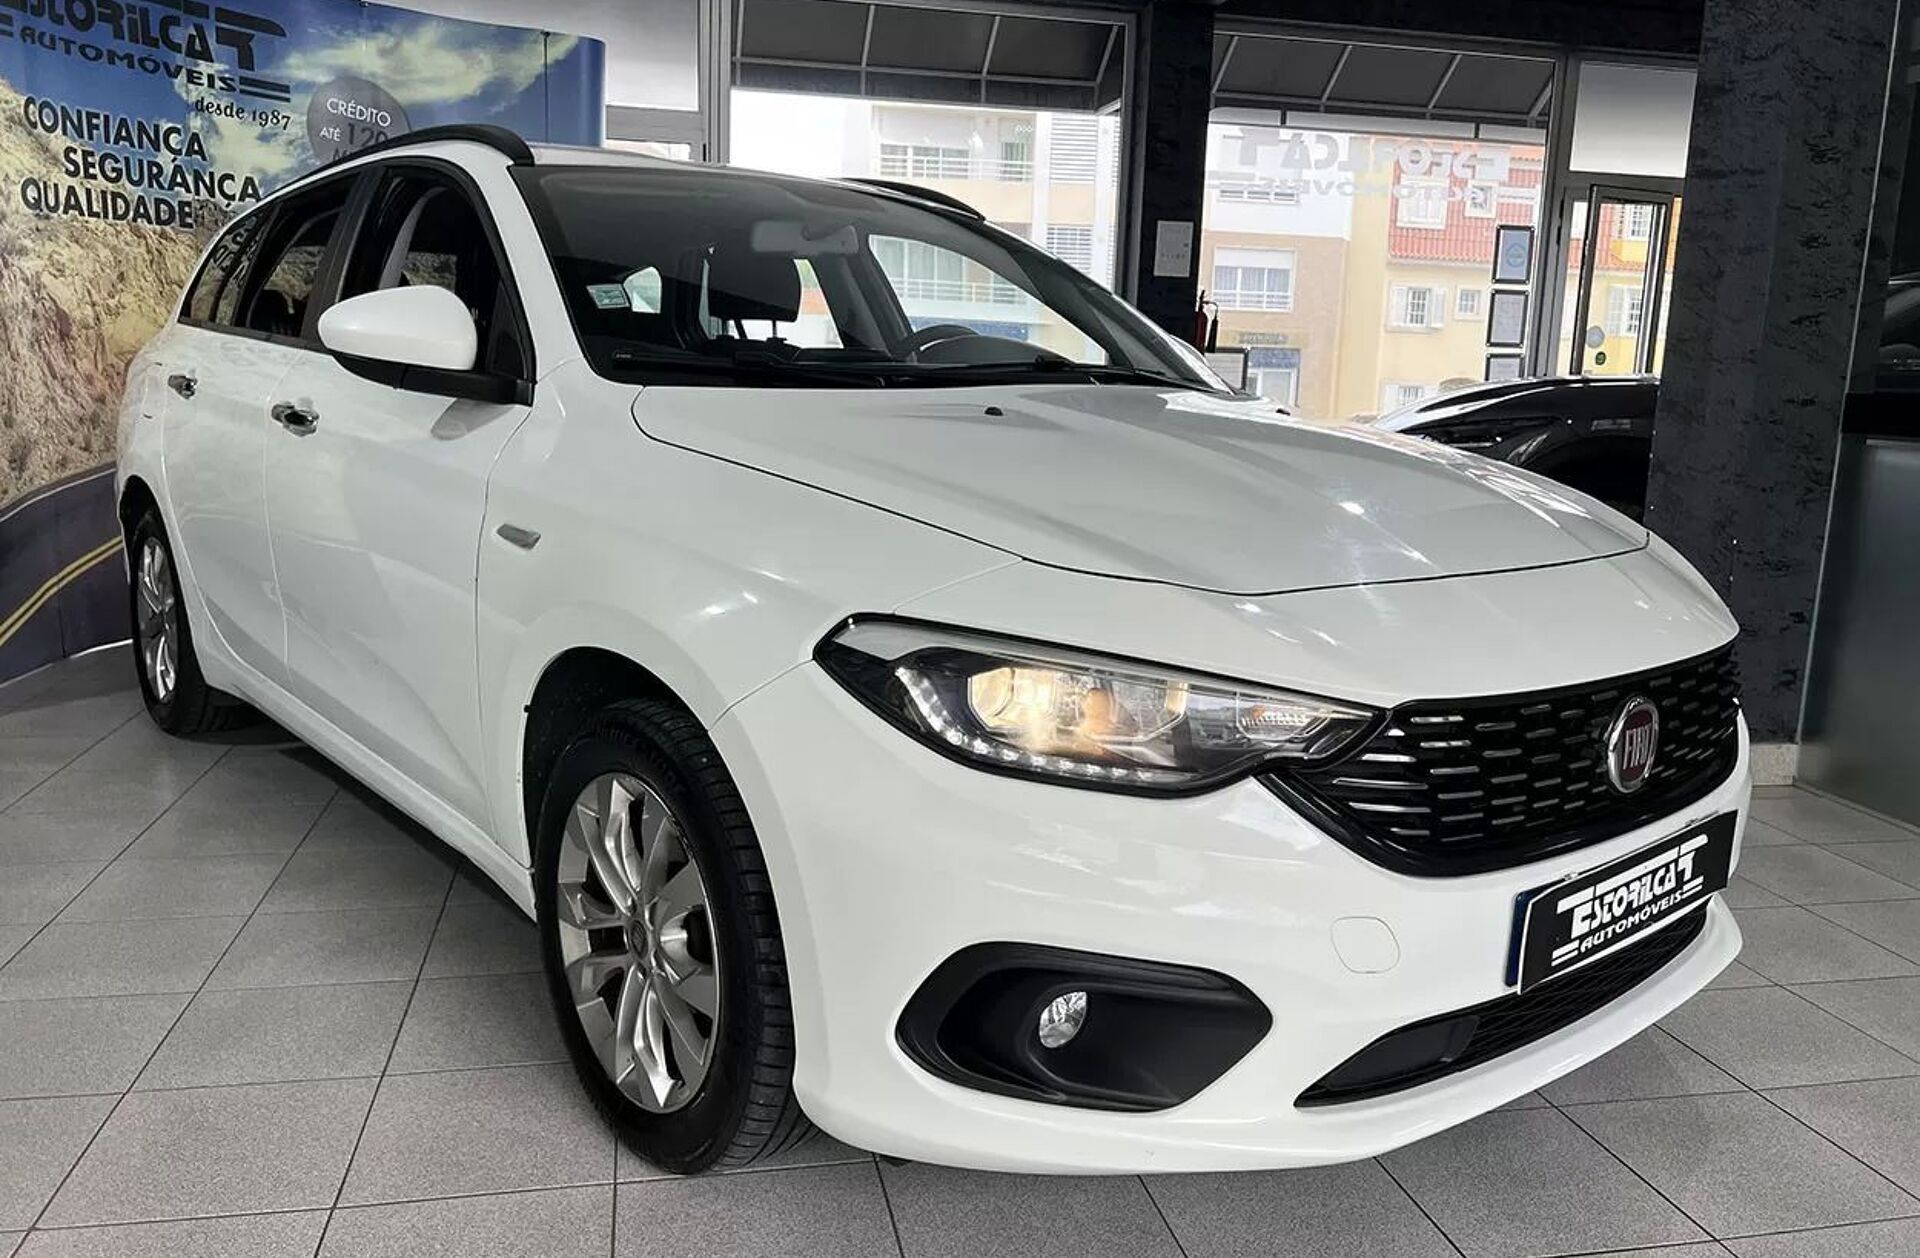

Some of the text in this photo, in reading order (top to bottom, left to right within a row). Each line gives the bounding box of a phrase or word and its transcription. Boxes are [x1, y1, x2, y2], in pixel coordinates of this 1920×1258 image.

[20, 26, 237, 93] AUTOMÓVEIS
[24, 96, 206, 163] CONFIANÇA
[195, 97, 291, 130] desde 1987
[320, 127, 341, 142] ATÉ
[327, 98, 391, 127] CRÉDITO
[21, 177, 194, 229] QUALIDADE
[64, 147, 261, 207] SEGURANÇA
[1580, 890, 1683, 953] AUTOMÓVEIS
